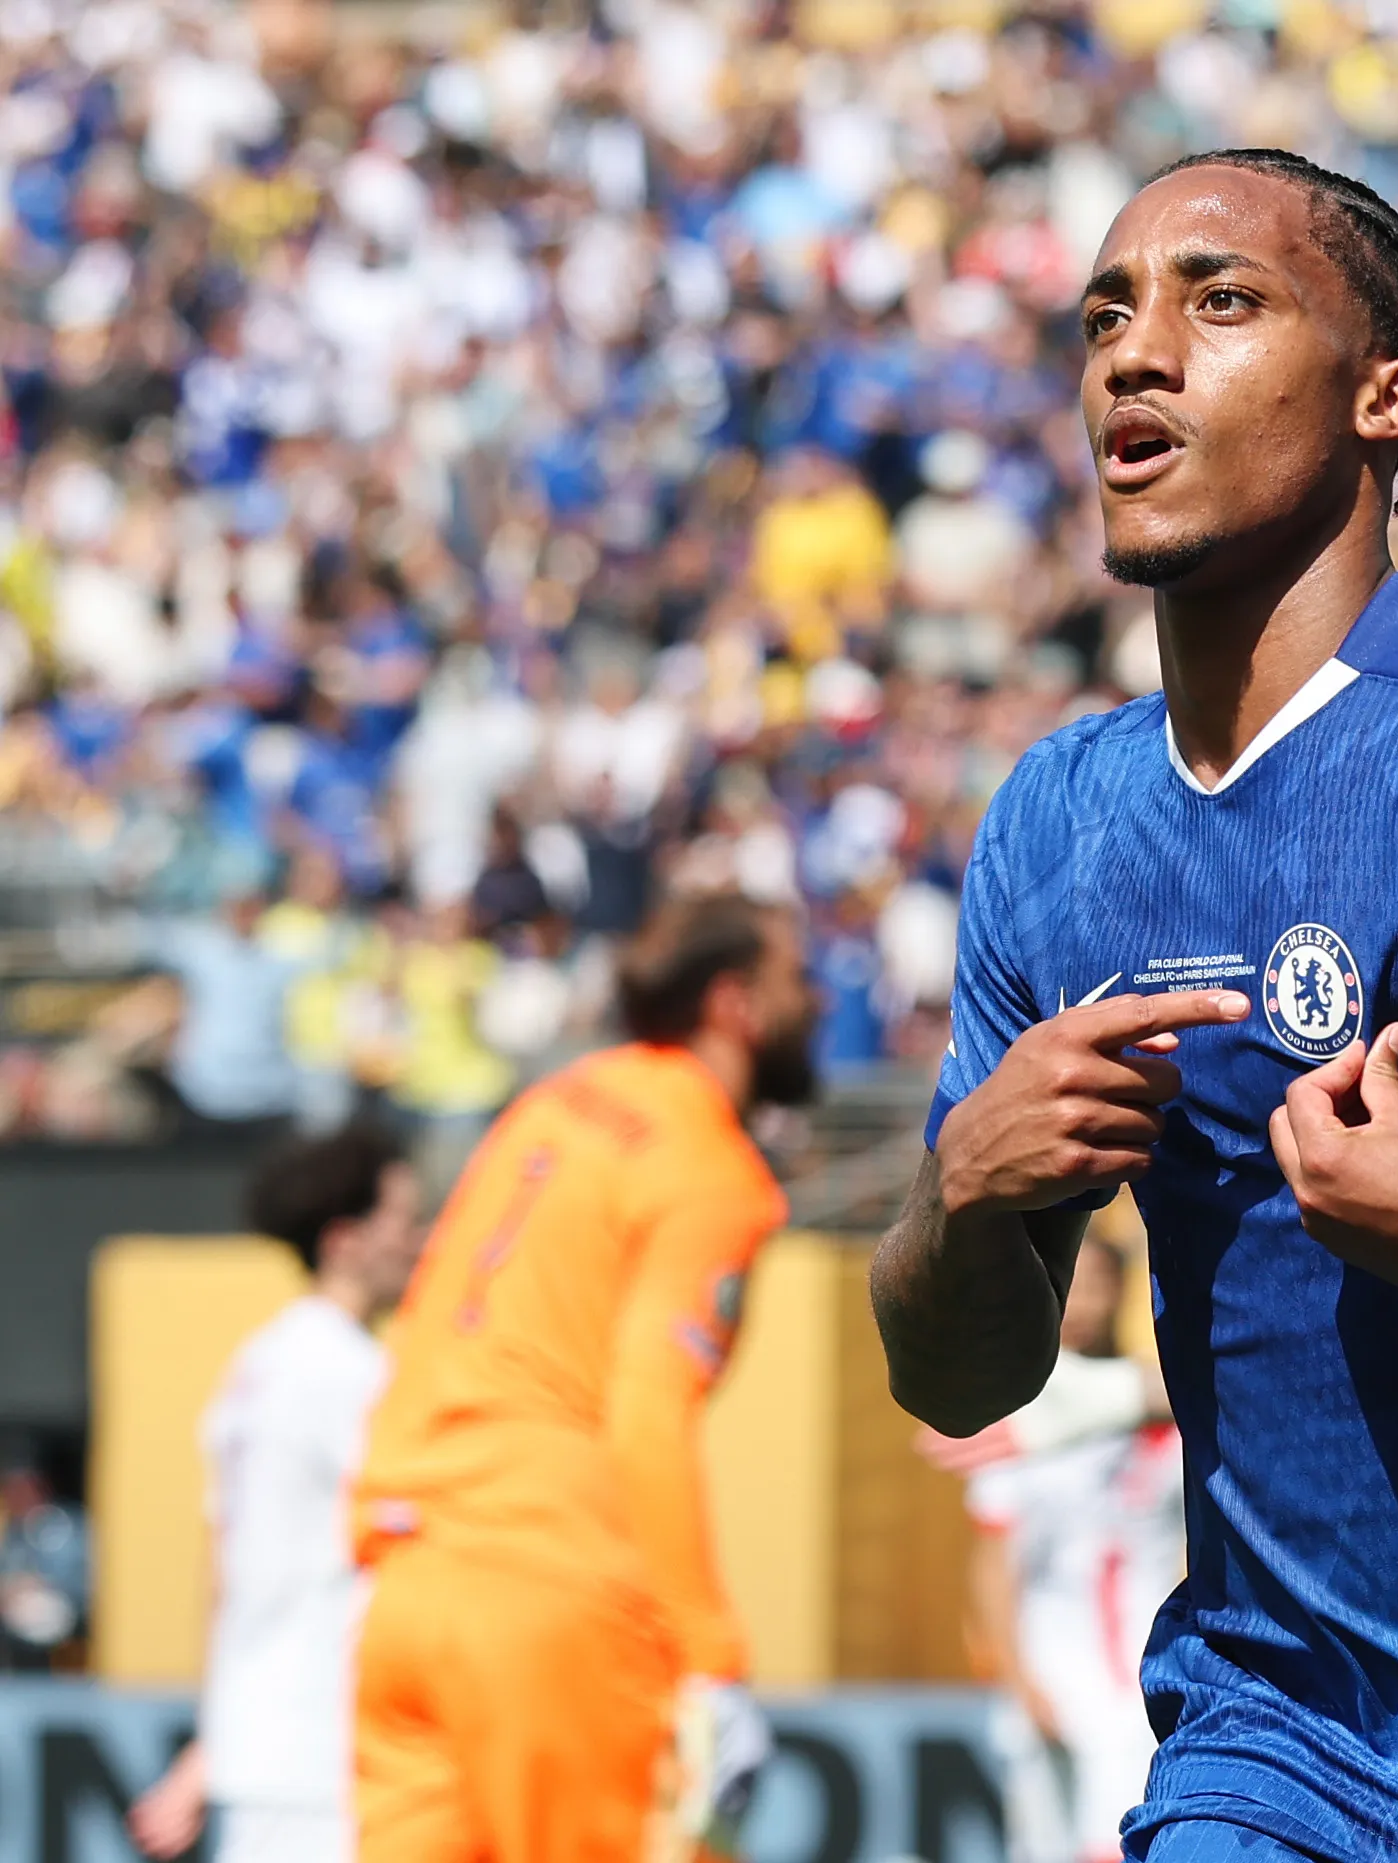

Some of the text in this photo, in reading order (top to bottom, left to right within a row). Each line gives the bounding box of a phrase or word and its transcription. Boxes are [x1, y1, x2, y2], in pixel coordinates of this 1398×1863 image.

[1280, 929, 1341, 960] CHELSEA
[1148, 953, 1244, 970] FIFA CLUB WORLD CUP FINAL
[1133, 965, 1256, 985] CHELSEA FC vs PARIS SAINT-GERMAIN
[1281, 1027, 1352, 1052] FOOTBALL CLUB
